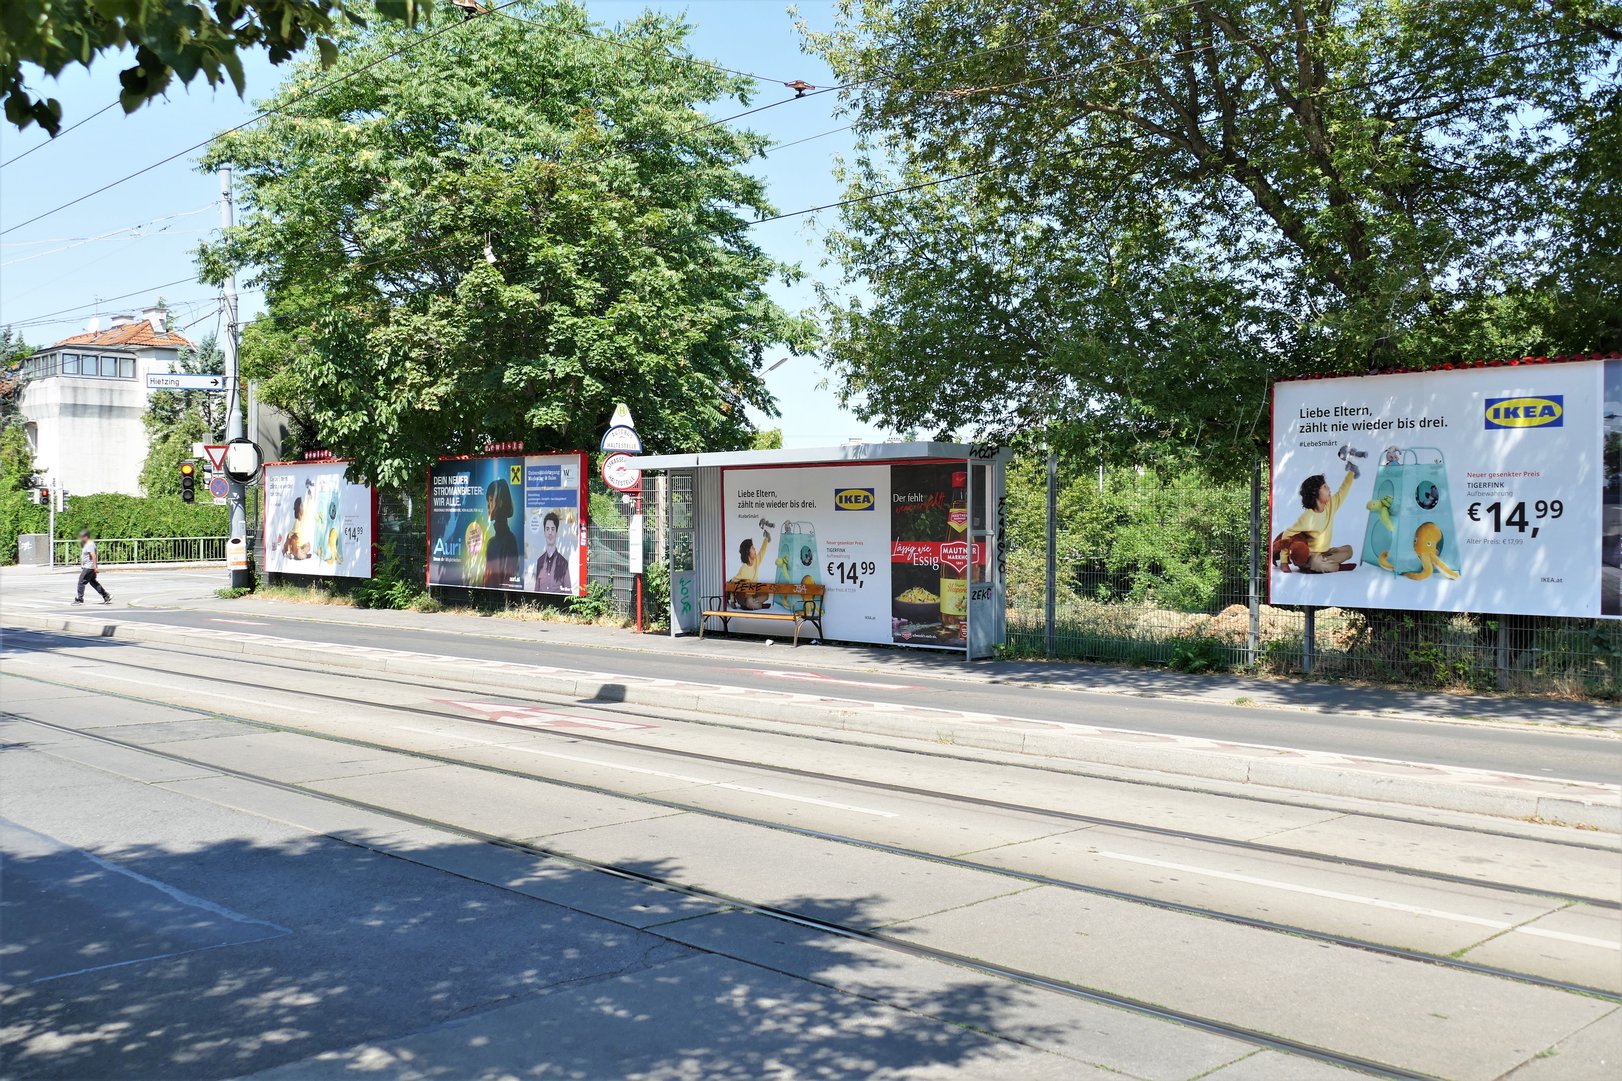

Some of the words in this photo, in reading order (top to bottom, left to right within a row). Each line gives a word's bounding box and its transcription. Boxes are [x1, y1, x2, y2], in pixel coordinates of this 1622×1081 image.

[150, 378, 180, 387] Hietzing
[619, 406, 625, 415] H
[1300, 407, 1330, 418] Liebe
[1334, 406, 1373, 417] Eltern,
[1492, 404, 1557, 420] IKEA
[1300, 423, 1328, 433] zählt
[1331, 422, 1349, 432] nie
[1352, 419, 1394, 431] wieder
[1397, 417, 1415, 429] bis
[1419, 416, 1448, 428] drei.
[611, 429, 633, 439] AUTOBUS
[606, 442, 637, 450] HALTESTELLE
[433, 476, 447, 485] DEIN
[448, 475, 468, 485] NEUER
[1488, 471, 1522, 479] gesenkter
[608, 475, 636, 487] HALTESTELLE
[433, 486, 484, 496] STROMANBIETER:
[738, 490, 755, 498] Liebe
[756, 489, 777, 498] Eltern,
[433, 497, 445, 507] WIR
[445, 497, 461, 507] ALLE.
[838, 495, 871, 504] IKEA
[893, 494, 906, 503] Der
[907, 493, 924, 503] fehlt
[738, 500, 753, 509] zählt
[754, 500, 765, 508] nie
[766, 500, 788, 508] wieder
[789, 499, 800, 508] bis
[801, 499, 817, 508] drei.
[433, 537, 461, 556] Auri
[892, 536, 916, 560] Lässig
[917, 544, 932, 553] wie
[913, 552, 940, 571] Essig
